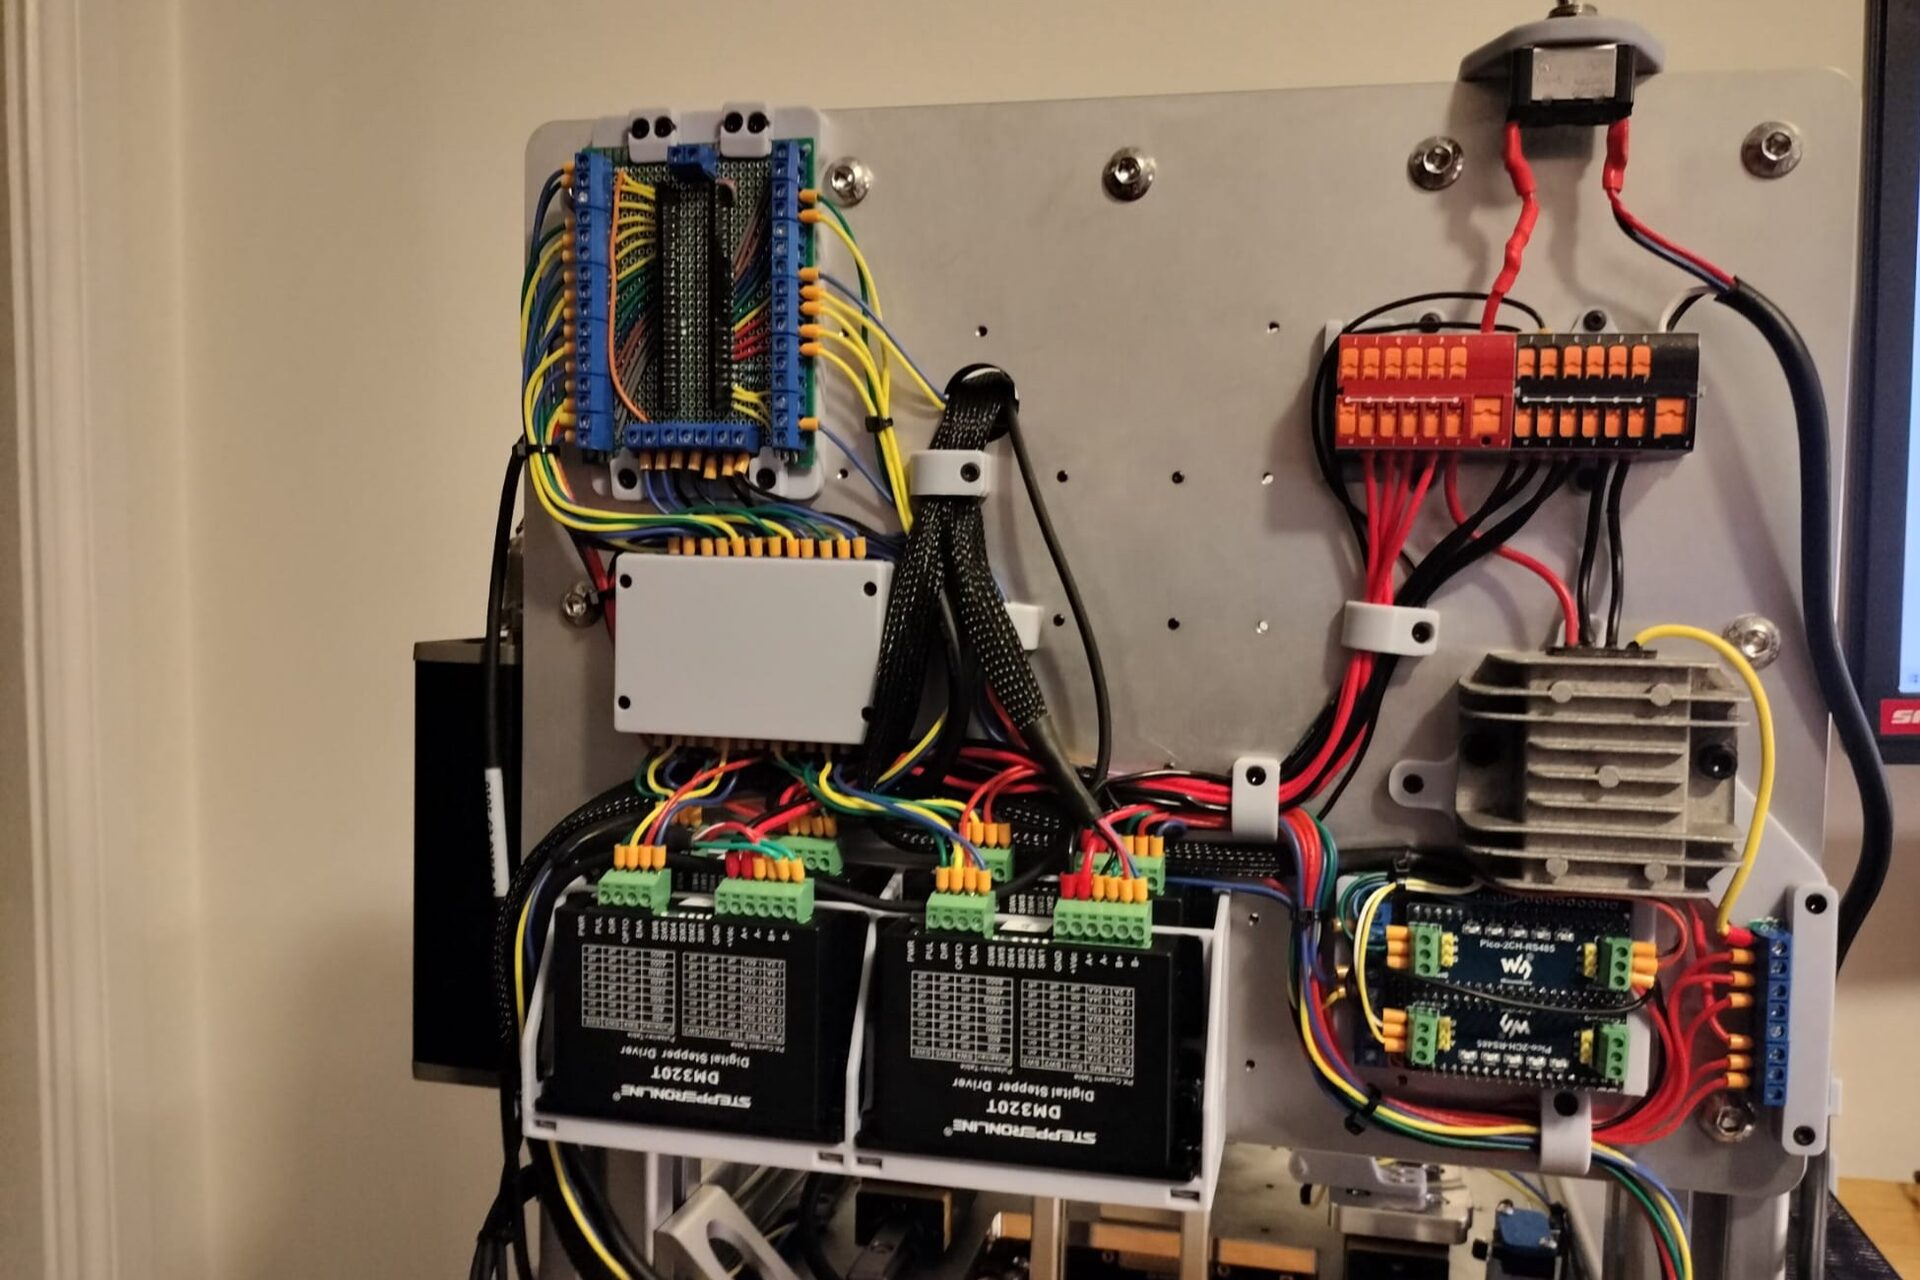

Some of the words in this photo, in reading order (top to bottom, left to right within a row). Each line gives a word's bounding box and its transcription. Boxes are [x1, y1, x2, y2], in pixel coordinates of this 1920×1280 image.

[620, 1045, 656, 1060] Driver
[661, 1049, 708, 1065] Stepper
[710, 1052, 750, 1069] Digital
[650, 1065, 720, 1085] DM320T
[952, 1077, 992, 1093] Driver
[998, 1081, 1049, 1098] Stepper
[620, 1083, 752, 1109] STEPPERONLINE
[1051, 1086, 1095, 1103] Digital
[986, 1098, 1062, 1120] DM320T
[952, 1118, 1097, 1145] STEPPERONLINE
